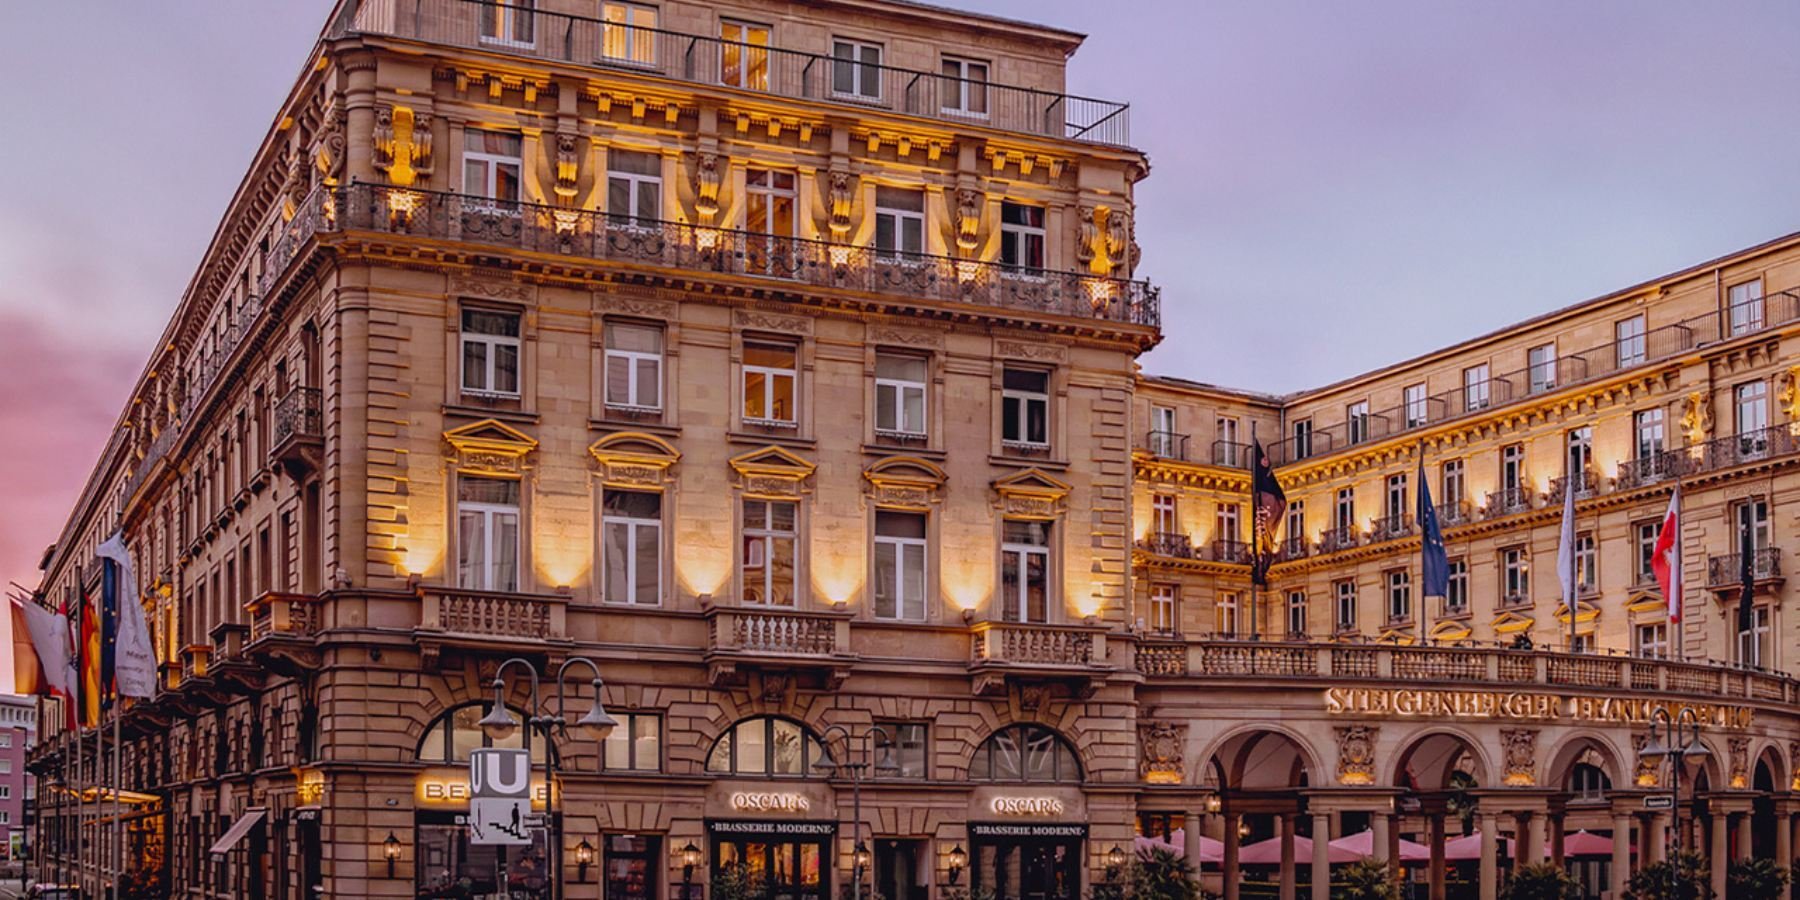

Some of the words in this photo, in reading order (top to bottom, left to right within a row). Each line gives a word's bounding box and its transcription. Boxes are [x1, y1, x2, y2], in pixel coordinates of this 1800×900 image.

[1326, 687, 1561, 718] STEIGENBERGER
[487, 753, 528, 794] U
[714, 822, 775, 832] BRASSERIE
[777, 824, 832, 834] MODERNE
[976, 826, 1031, 835] BRASSERIE
[1032, 827, 1082, 836] MODERNE
